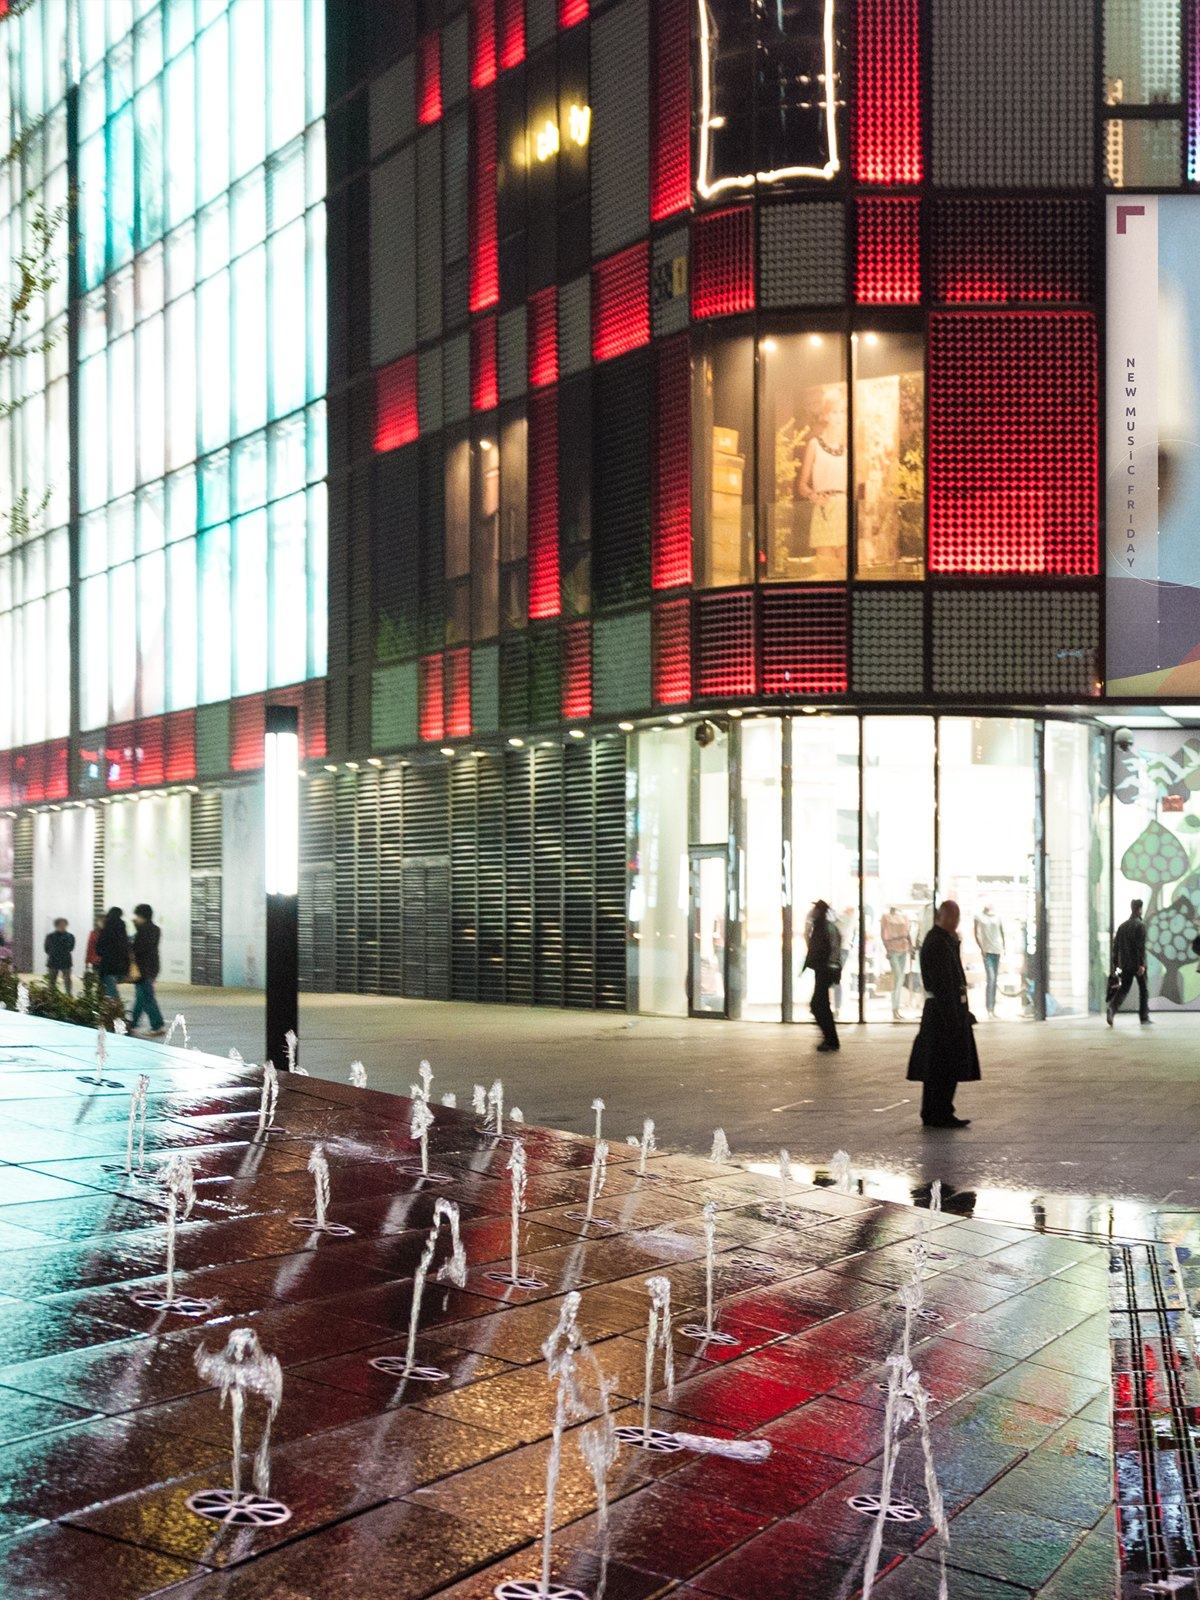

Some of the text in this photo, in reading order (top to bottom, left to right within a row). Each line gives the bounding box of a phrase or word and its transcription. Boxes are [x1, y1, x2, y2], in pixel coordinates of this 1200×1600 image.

[1125, 358, 1137, 567] NEW MUSIC FRIDAY
